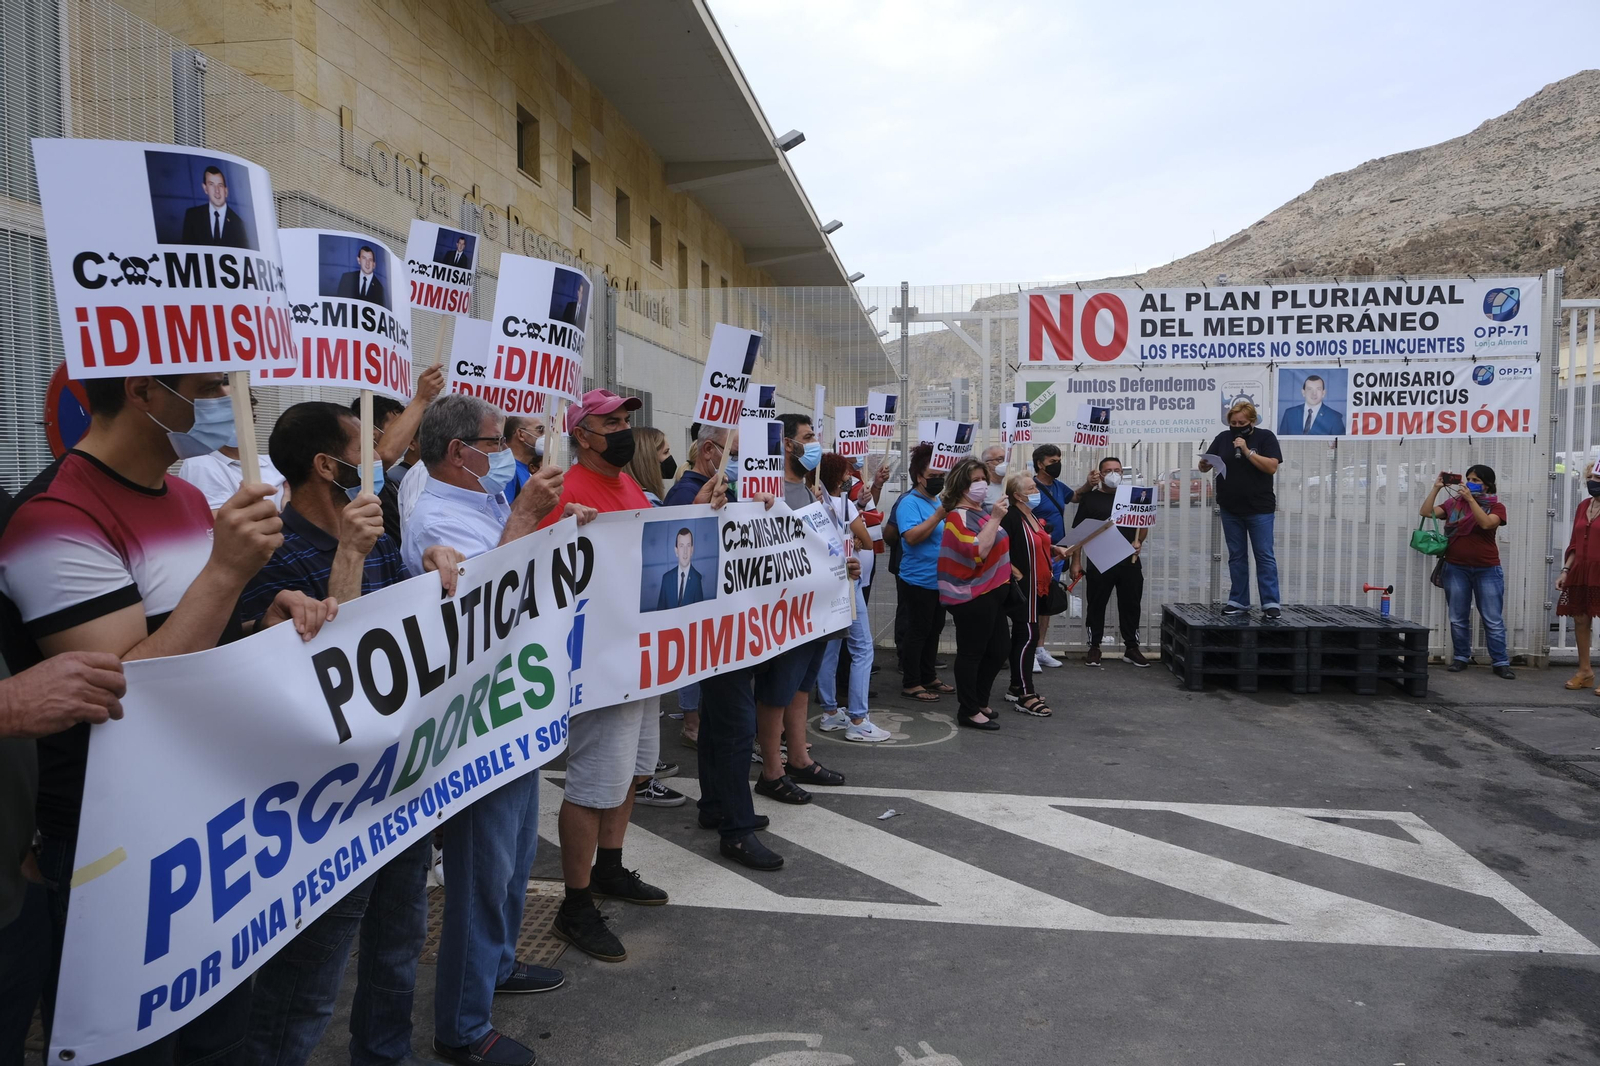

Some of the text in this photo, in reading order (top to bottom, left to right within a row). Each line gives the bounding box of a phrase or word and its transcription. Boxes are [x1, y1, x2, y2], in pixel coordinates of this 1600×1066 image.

[340, 104, 450, 220] Lonja
[75, 296, 296, 368] ¡DIMISIÓN!
[1029, 285, 1464, 362] NO AL PLAN PLURIANUAL
[1140, 309, 1440, 338] DEL MEDITERRÁNEO
[1474, 325, 1529, 339] OPP-71
[1140, 337, 1466, 360] LOS PESCADORES NO SOMOS DELINCUENTES
[1474, 339, 1496, 348] Lonja
[1066, 377, 1216, 394] Juntos Defendemos
[1353, 371, 1455, 388] COMISARIO
[1499, 367, 1533, 376] OPP-71
[1086, 395, 1196, 411] nuestra Pesca
[1353, 388, 1469, 407] SINKEVICIUS
[1131, 419, 1157, 427] PESCA
[1172, 418, 1216, 426] ARRASTRE
[1351, 404, 1531, 436] ¡DIMISIÓN!
[723, 546, 812, 595] SINKEVICIUS
[311, 556, 540, 745] POLÍTICA
[638, 587, 815, 690] ¡DIMISIÓN!
[143, 641, 557, 966] PESCADORES
[136, 949, 221, 1032] POR
[231, 904, 287, 970] UNA
[293, 832, 367, 919] PESCA
[368, 741, 516, 857] RESPONSABLE
[519, 733, 532, 761] Y
